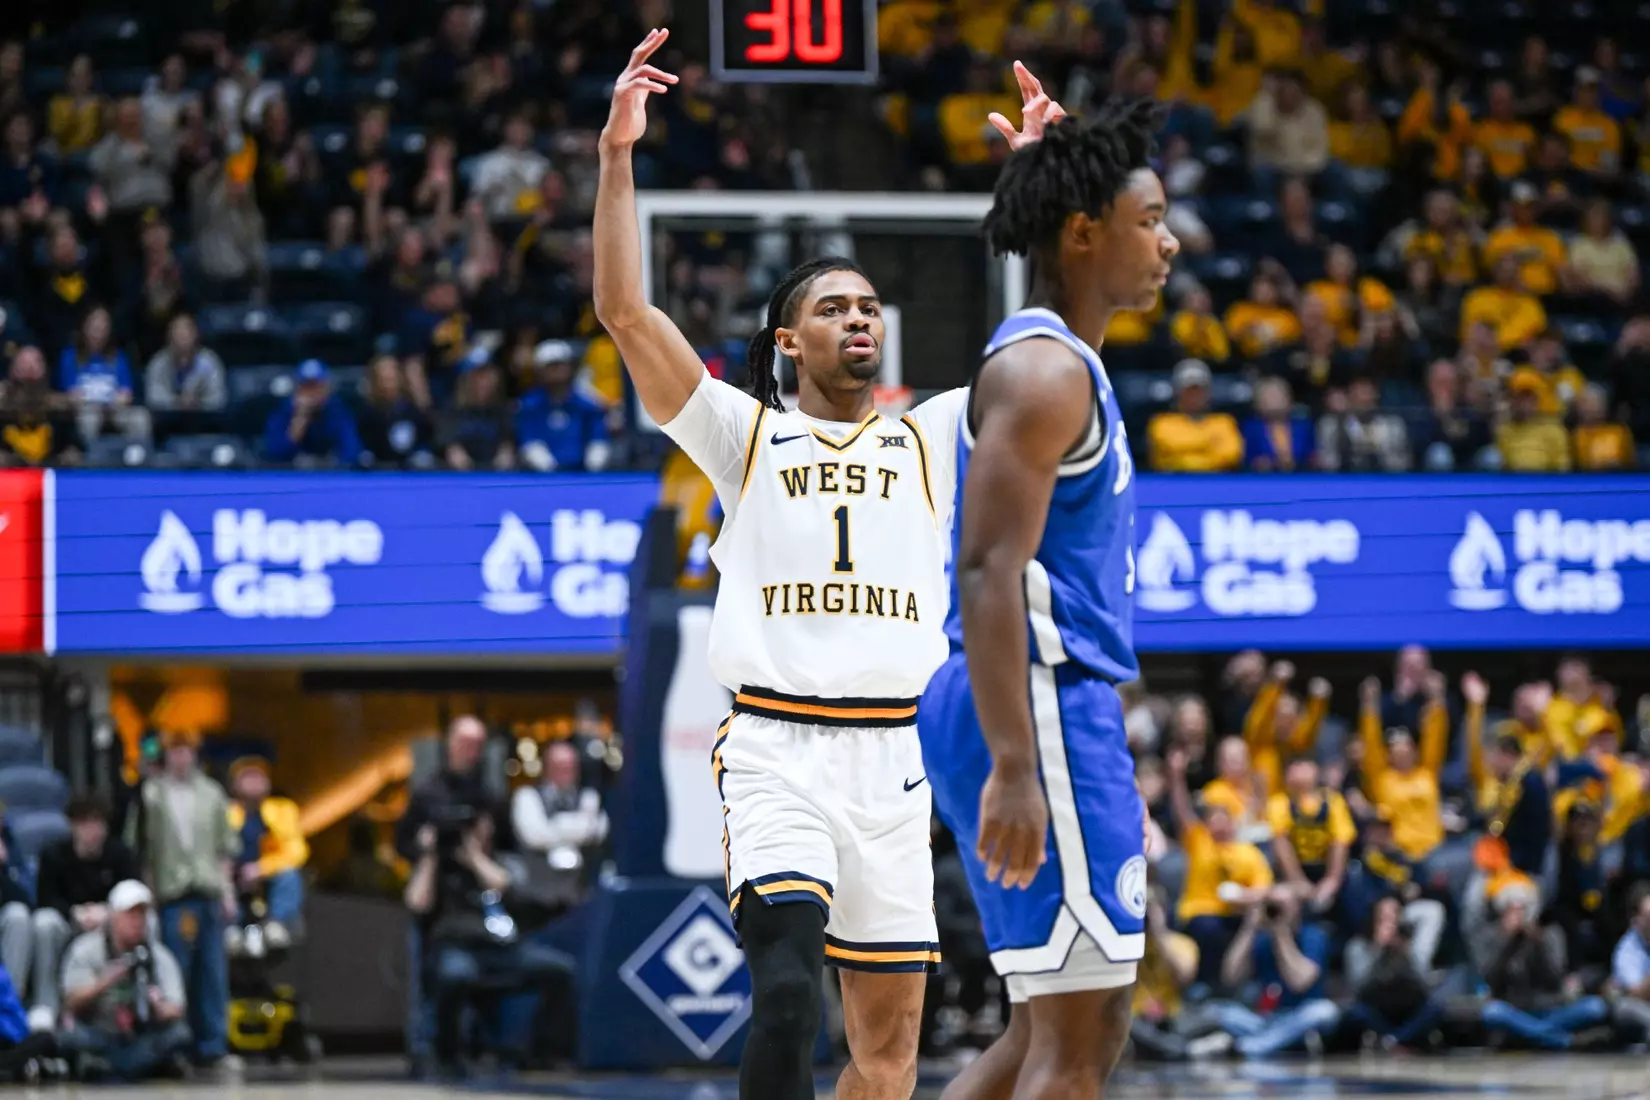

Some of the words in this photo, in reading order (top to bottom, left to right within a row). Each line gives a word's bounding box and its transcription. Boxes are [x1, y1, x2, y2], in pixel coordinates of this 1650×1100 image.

[744, 0, 843, 63] 30
[778, 461, 899, 500] WEST
[213, 508, 384, 570] Hope
[831, 503, 855, 574] 1
[1201, 508, 1360, 570] Hope
[212, 562, 335, 618] Gas
[761, 582, 920, 622] VIRGINIA
[1201, 560, 1317, 616] Gas
[1513, 561, 1624, 615] Gas
